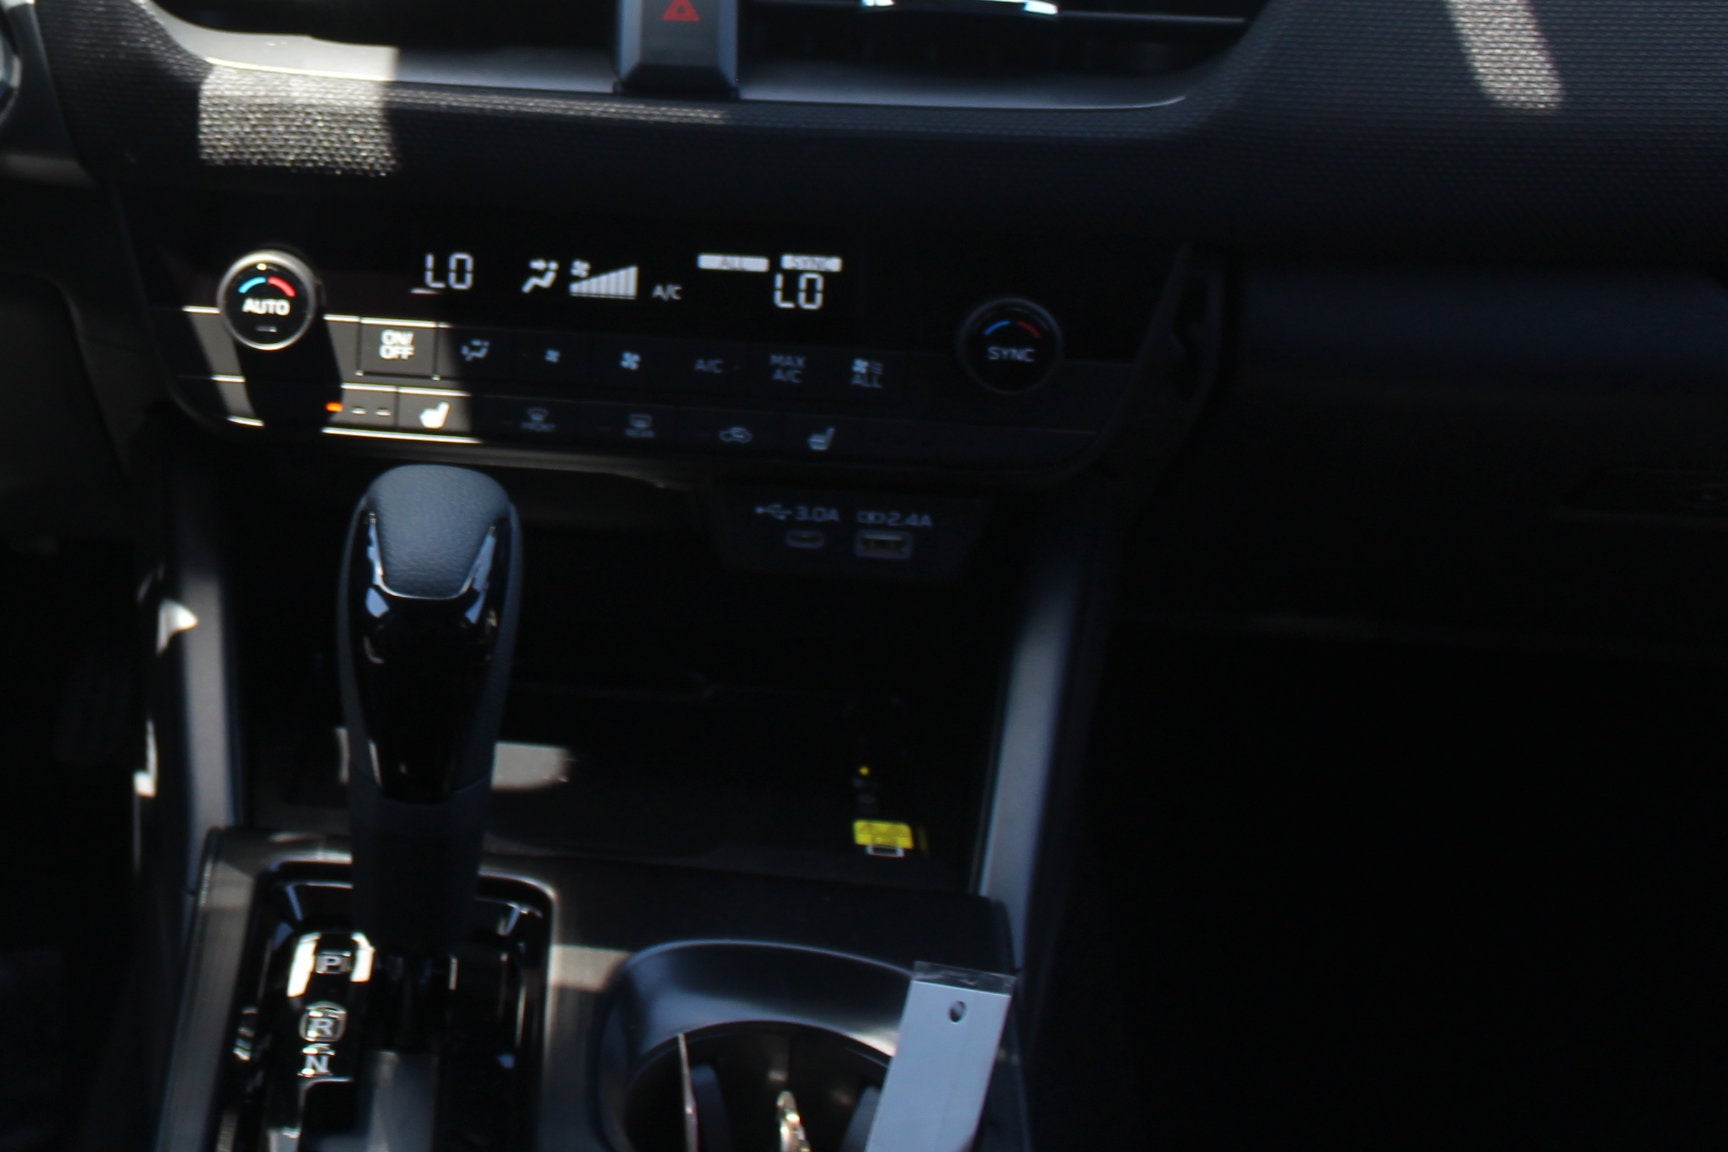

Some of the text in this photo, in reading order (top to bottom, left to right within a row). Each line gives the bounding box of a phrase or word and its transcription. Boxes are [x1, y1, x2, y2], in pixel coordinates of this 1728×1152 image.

[424, 252, 474, 290] LO
[652, 284, 683, 300] A/C
[774, 272, 823, 310] LO
[241, 298, 290, 316] AUTO
[379, 344, 414, 360] OFF
[986, 345, 1036, 363] SYNC
[694, 358, 724, 374] A/C
[769, 354, 805, 368] MAX
[773, 369, 803, 384] A/C
[850, 374, 883, 388] ALL
